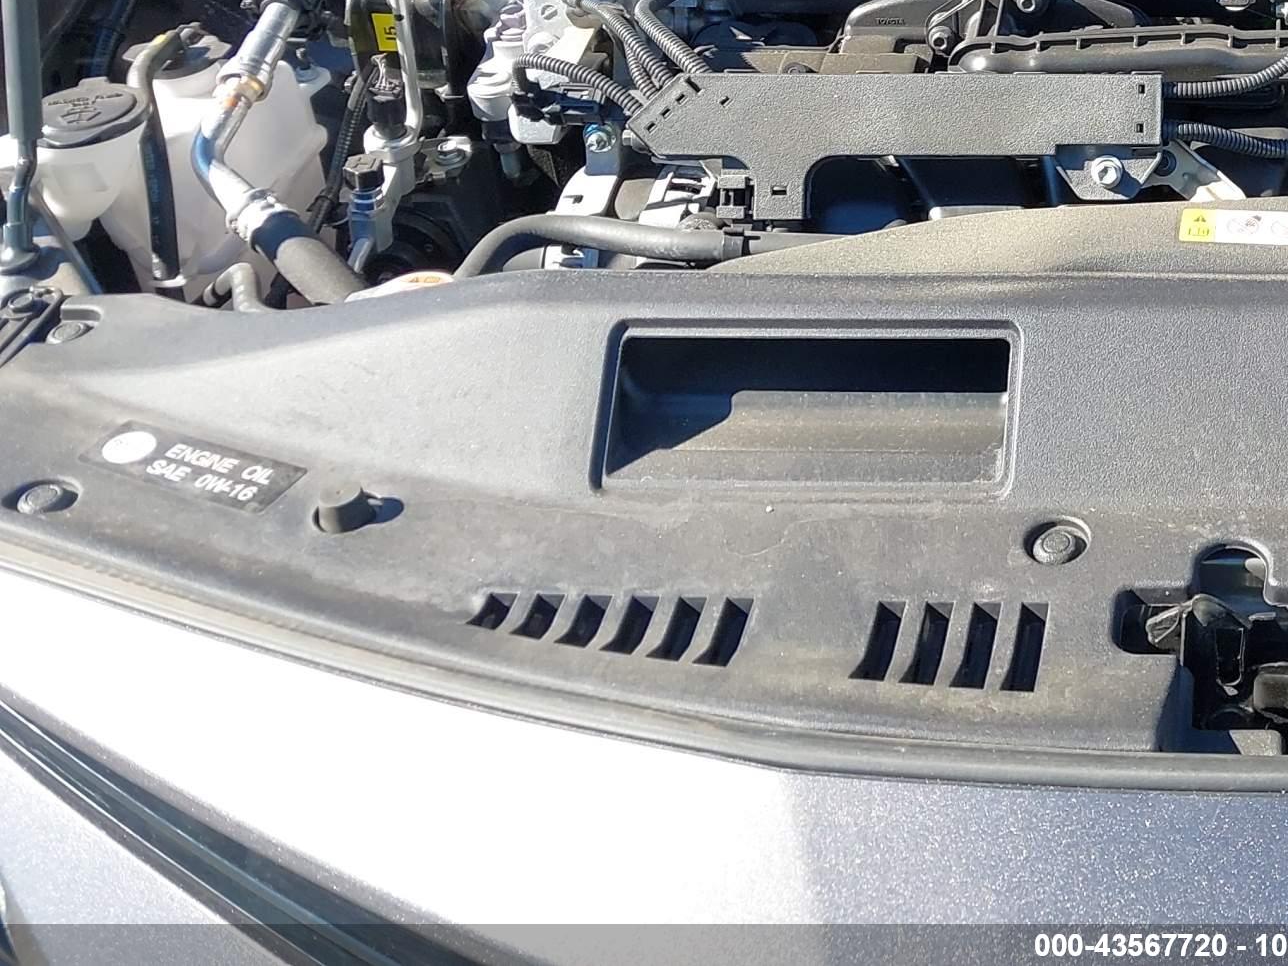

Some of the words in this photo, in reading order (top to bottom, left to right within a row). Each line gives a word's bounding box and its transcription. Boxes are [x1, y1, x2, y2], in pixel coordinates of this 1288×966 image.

[146, 459, 192, 482] SAE
[194, 474, 259, 501] 0W-16
[164, 443, 241, 474] ENGINE
[240, 465, 276, 485] OIL
